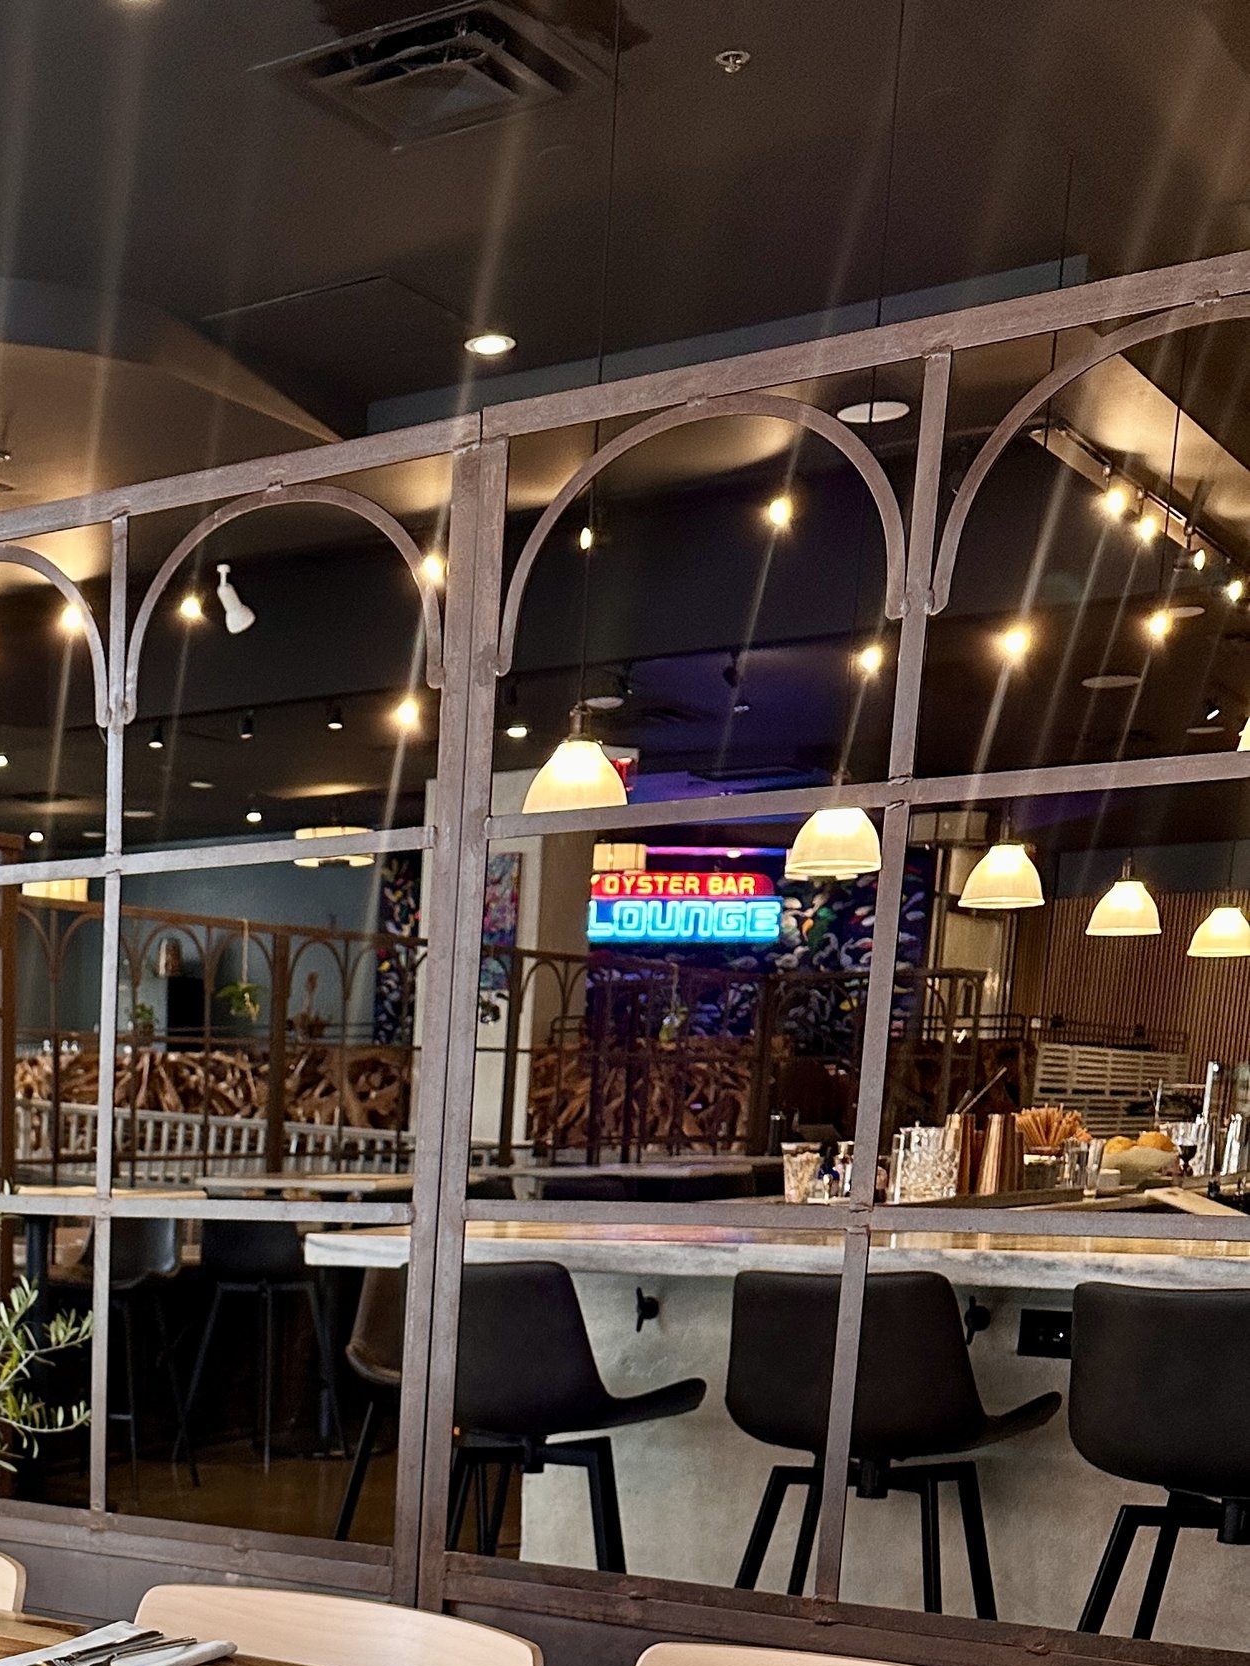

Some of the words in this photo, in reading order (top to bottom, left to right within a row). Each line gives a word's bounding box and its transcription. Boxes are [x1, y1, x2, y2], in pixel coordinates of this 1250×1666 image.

[604, 875, 700, 895] OYSTER
[708, 875, 756, 896] BAR
[587, 900, 781, 938] LOUNGE
